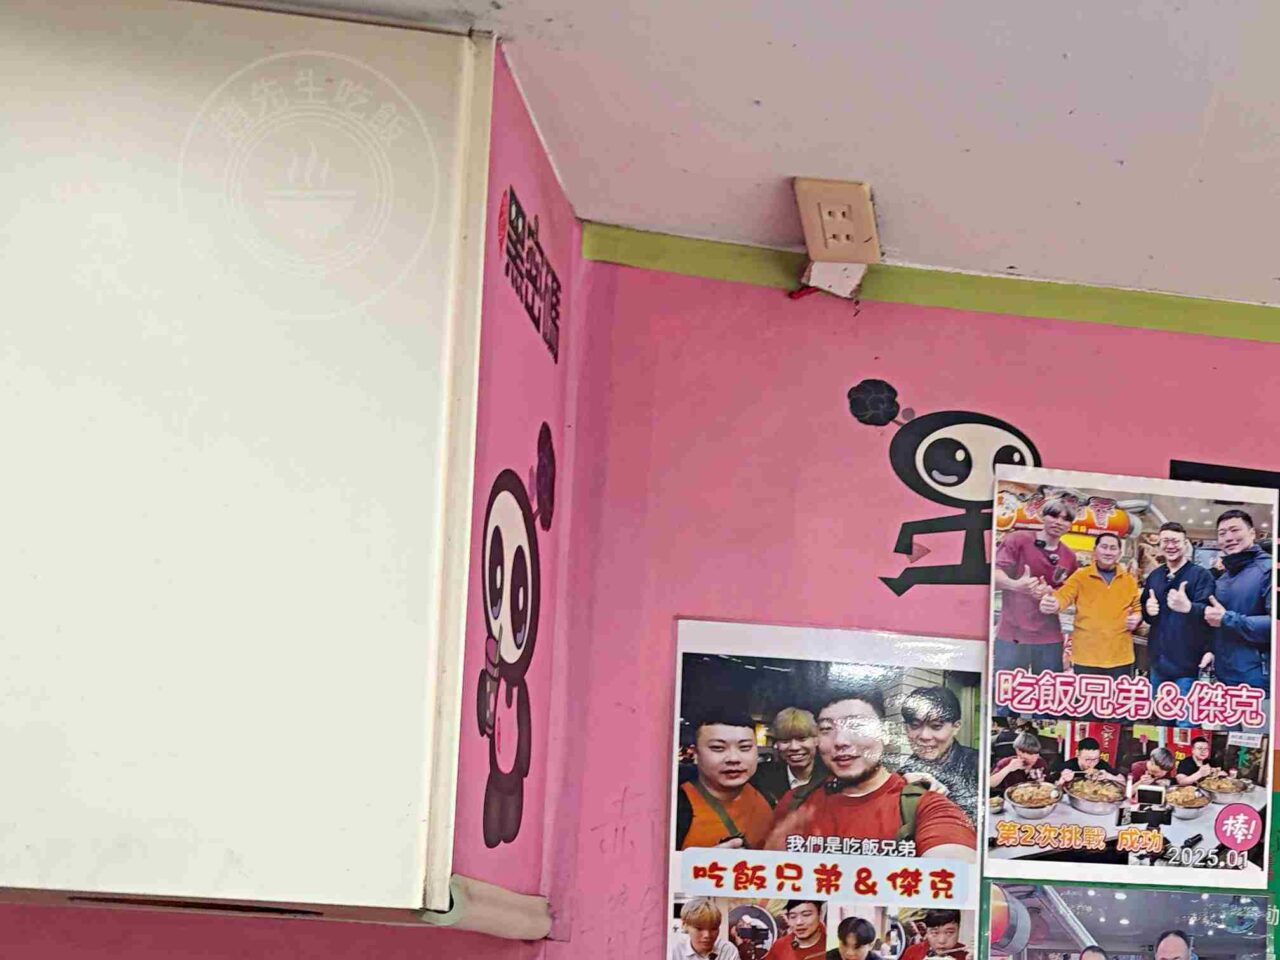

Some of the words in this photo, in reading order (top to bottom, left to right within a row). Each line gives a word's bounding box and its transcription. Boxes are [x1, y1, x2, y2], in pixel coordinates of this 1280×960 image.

[996, 669, 1266, 727] 吃飯兄弟&傑克
[786, 835, 917, 858] 我們是吃飯兄弟
[996, 821, 1106, 850] 第2次挑戰
[1117, 824, 1164, 852] 成功
[1168, 848, 1250, 871] 2025.01
[692, 860, 957, 900] 吃飯兄弟&傑克
